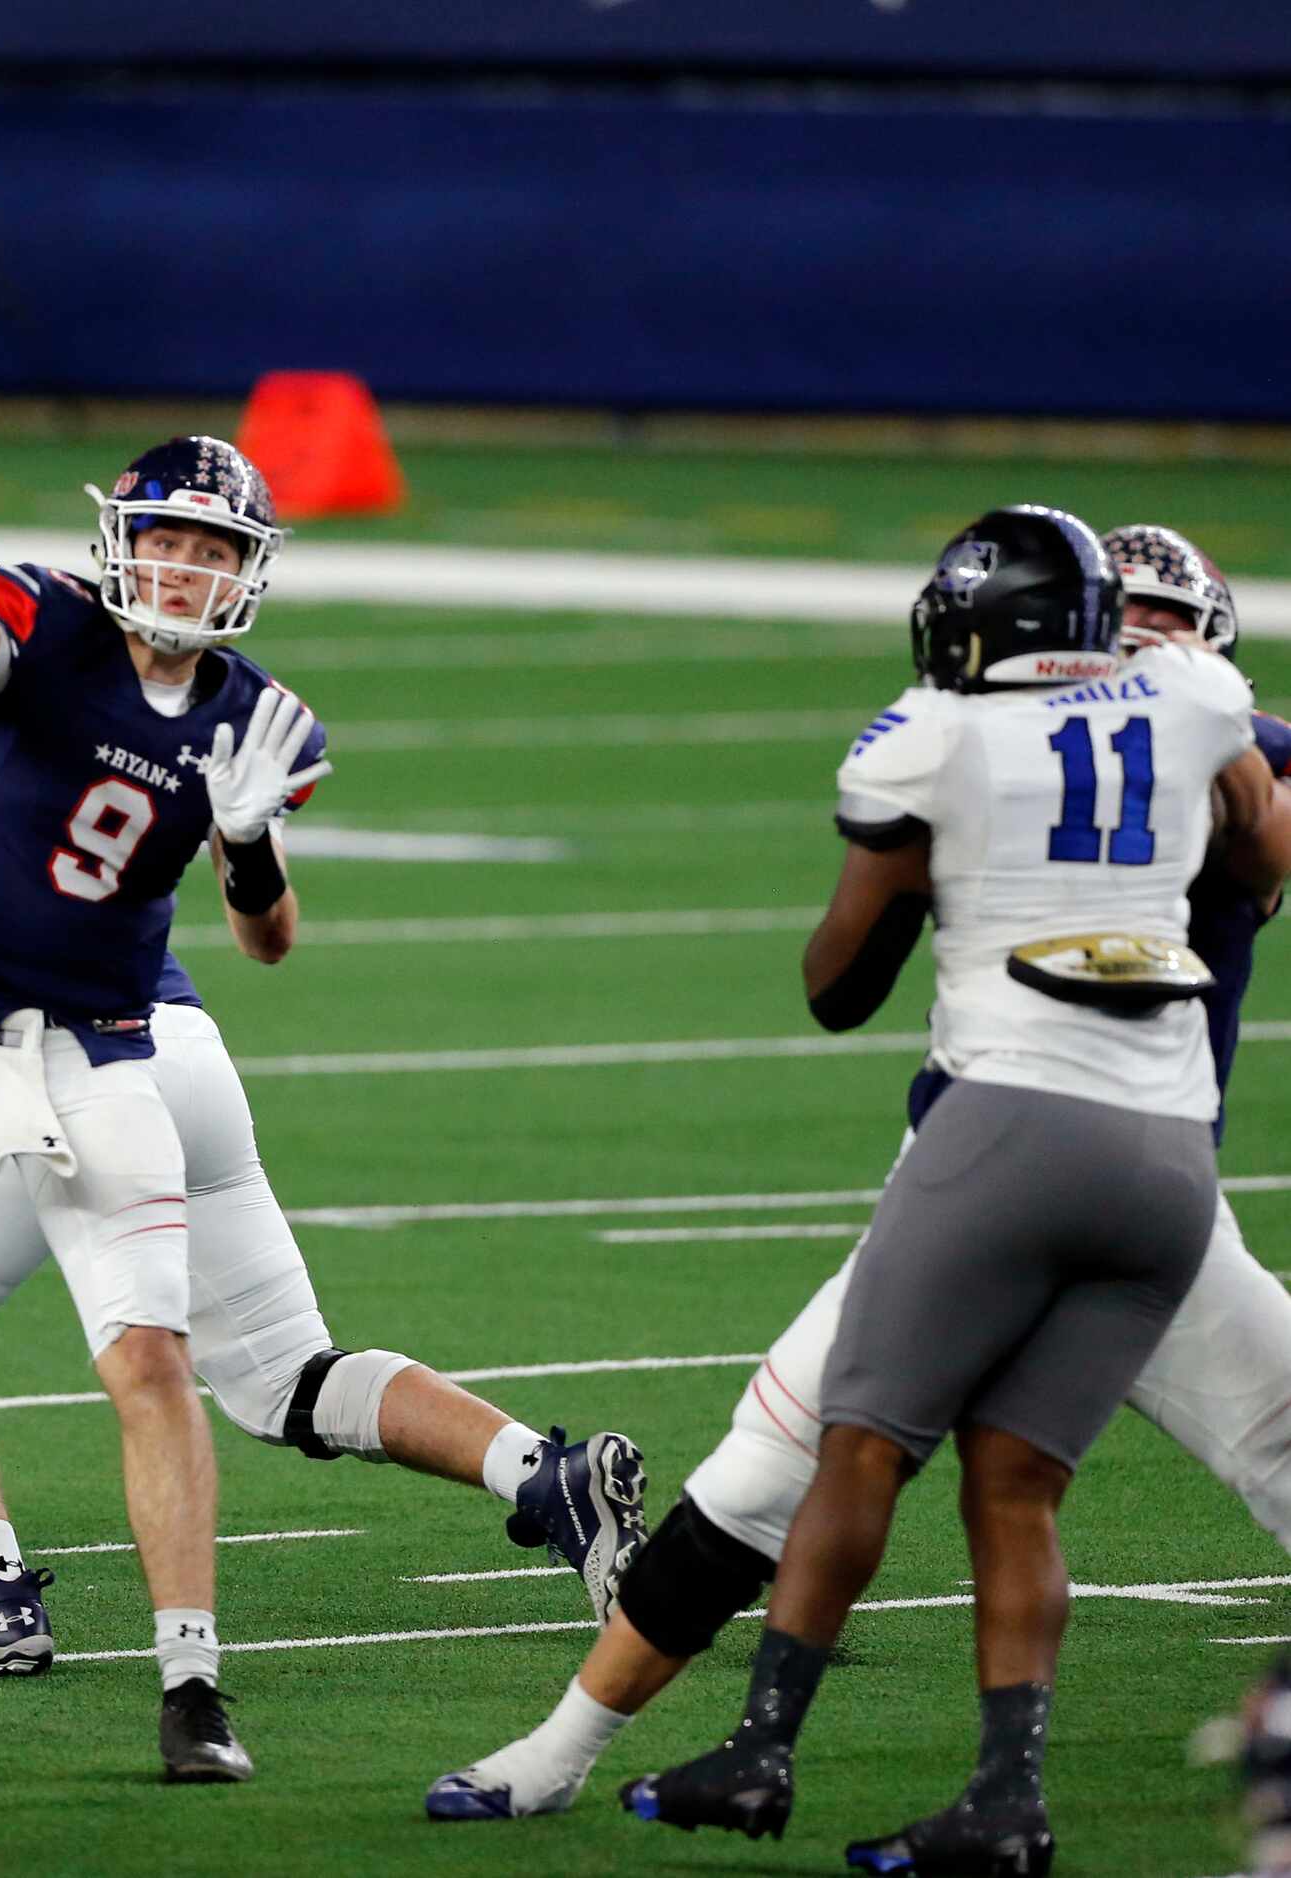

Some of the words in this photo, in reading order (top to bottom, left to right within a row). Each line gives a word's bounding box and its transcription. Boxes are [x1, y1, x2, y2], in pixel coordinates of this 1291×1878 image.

[109, 747, 168, 787] RYAN
[1048, 716, 1155, 865] 11
[49, 775, 158, 902] 9
